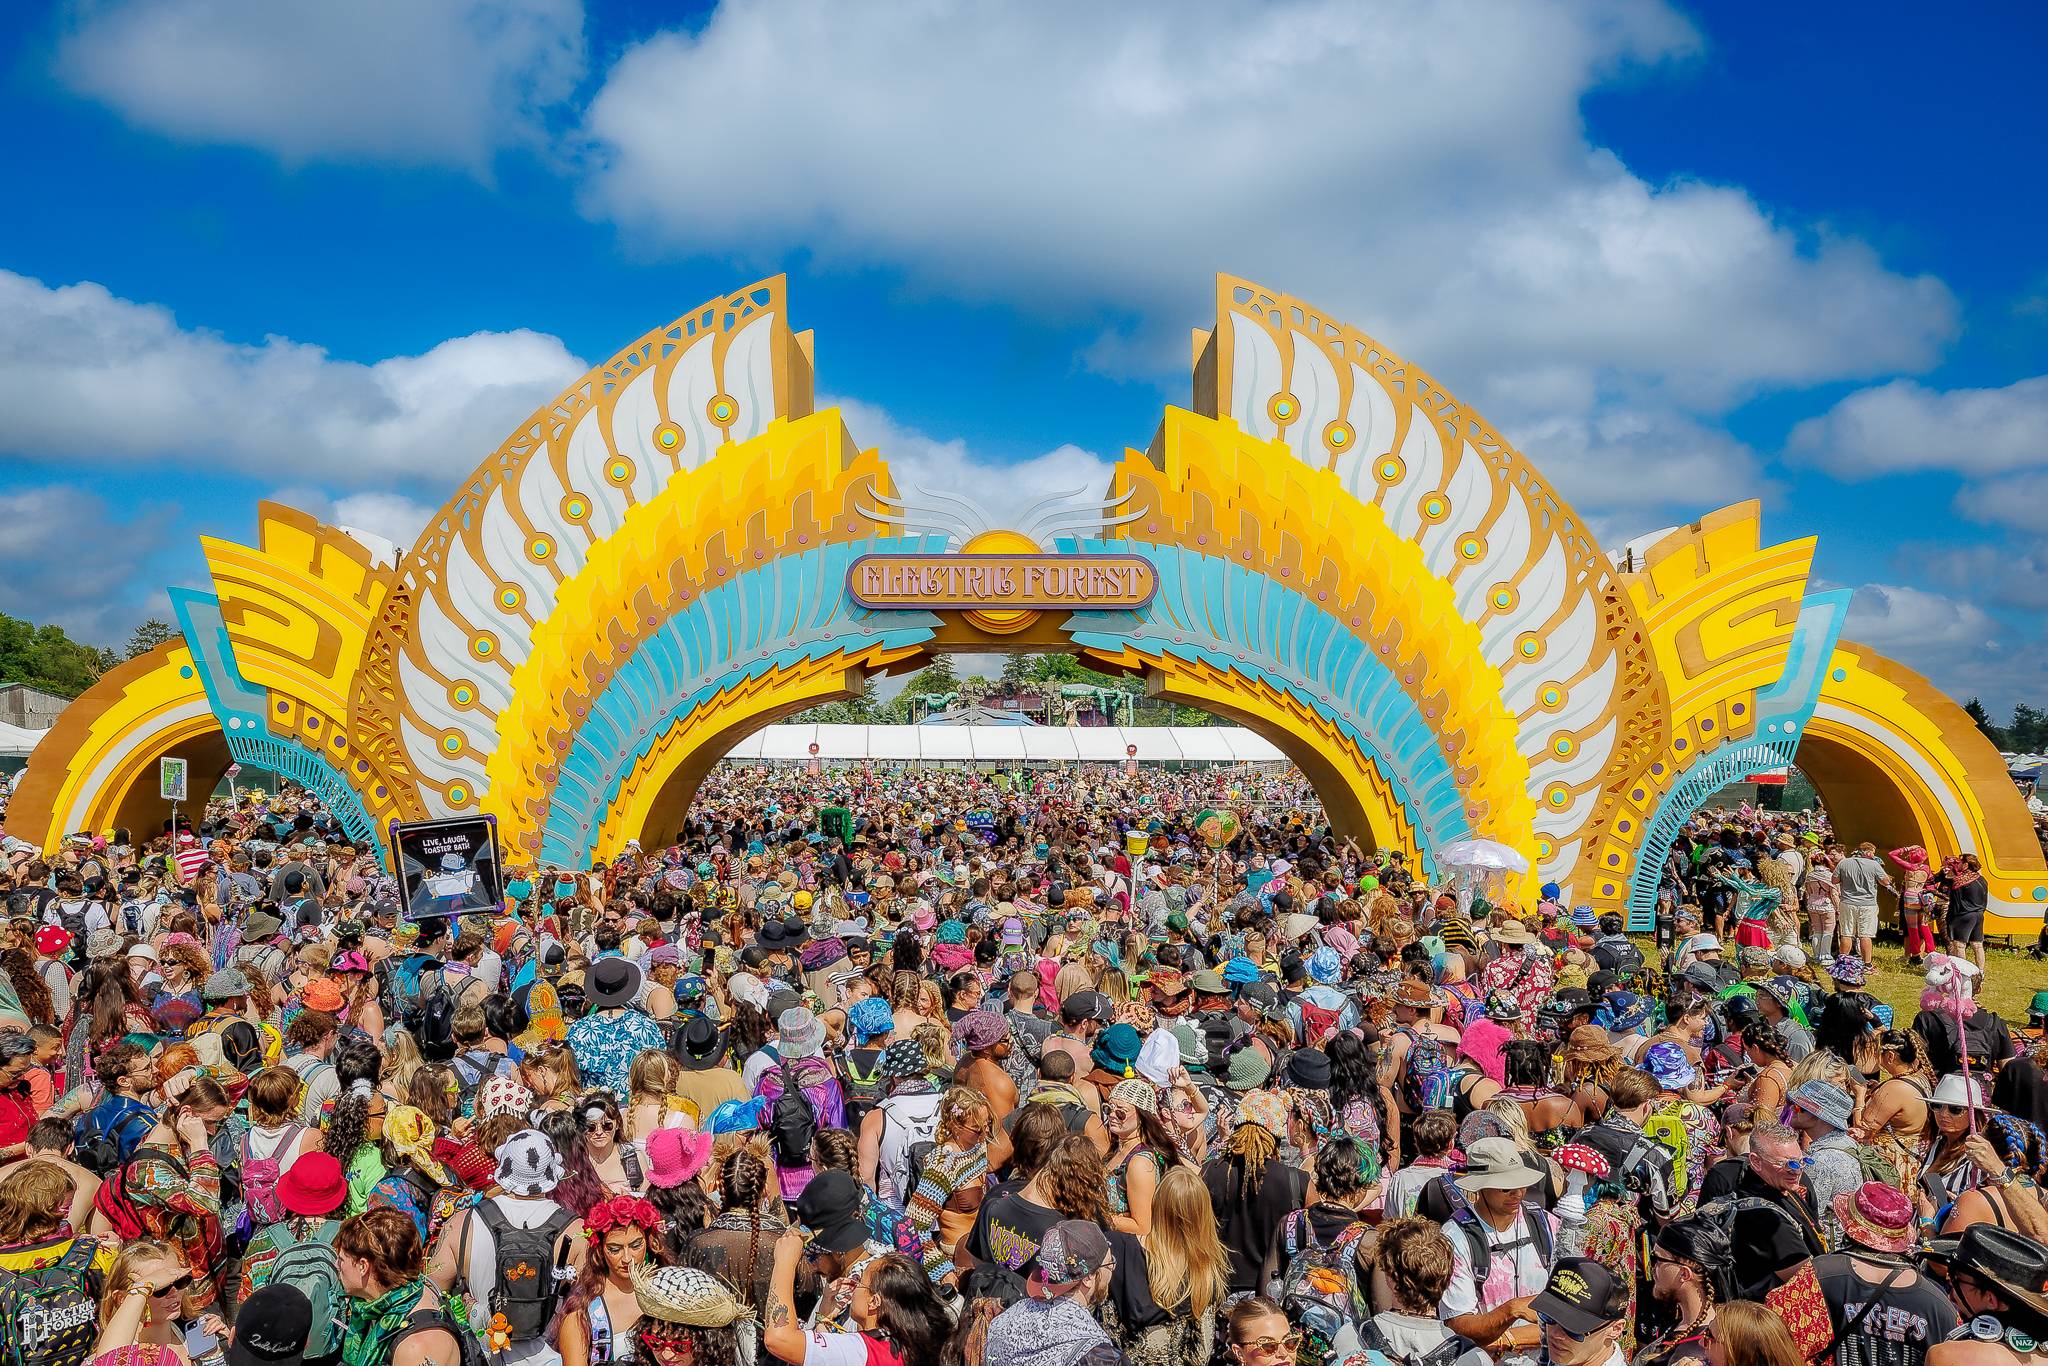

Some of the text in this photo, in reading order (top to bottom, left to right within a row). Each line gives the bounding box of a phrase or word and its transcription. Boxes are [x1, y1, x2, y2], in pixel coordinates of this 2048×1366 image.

[861, 565, 1145, 599] ELECTRIC FOREST
[422, 834, 469, 848] LIVE, LAUGH,
[423, 842, 471, 855] TOASTER BATH
[2015, 1339, 2034, 1347] ZYN
